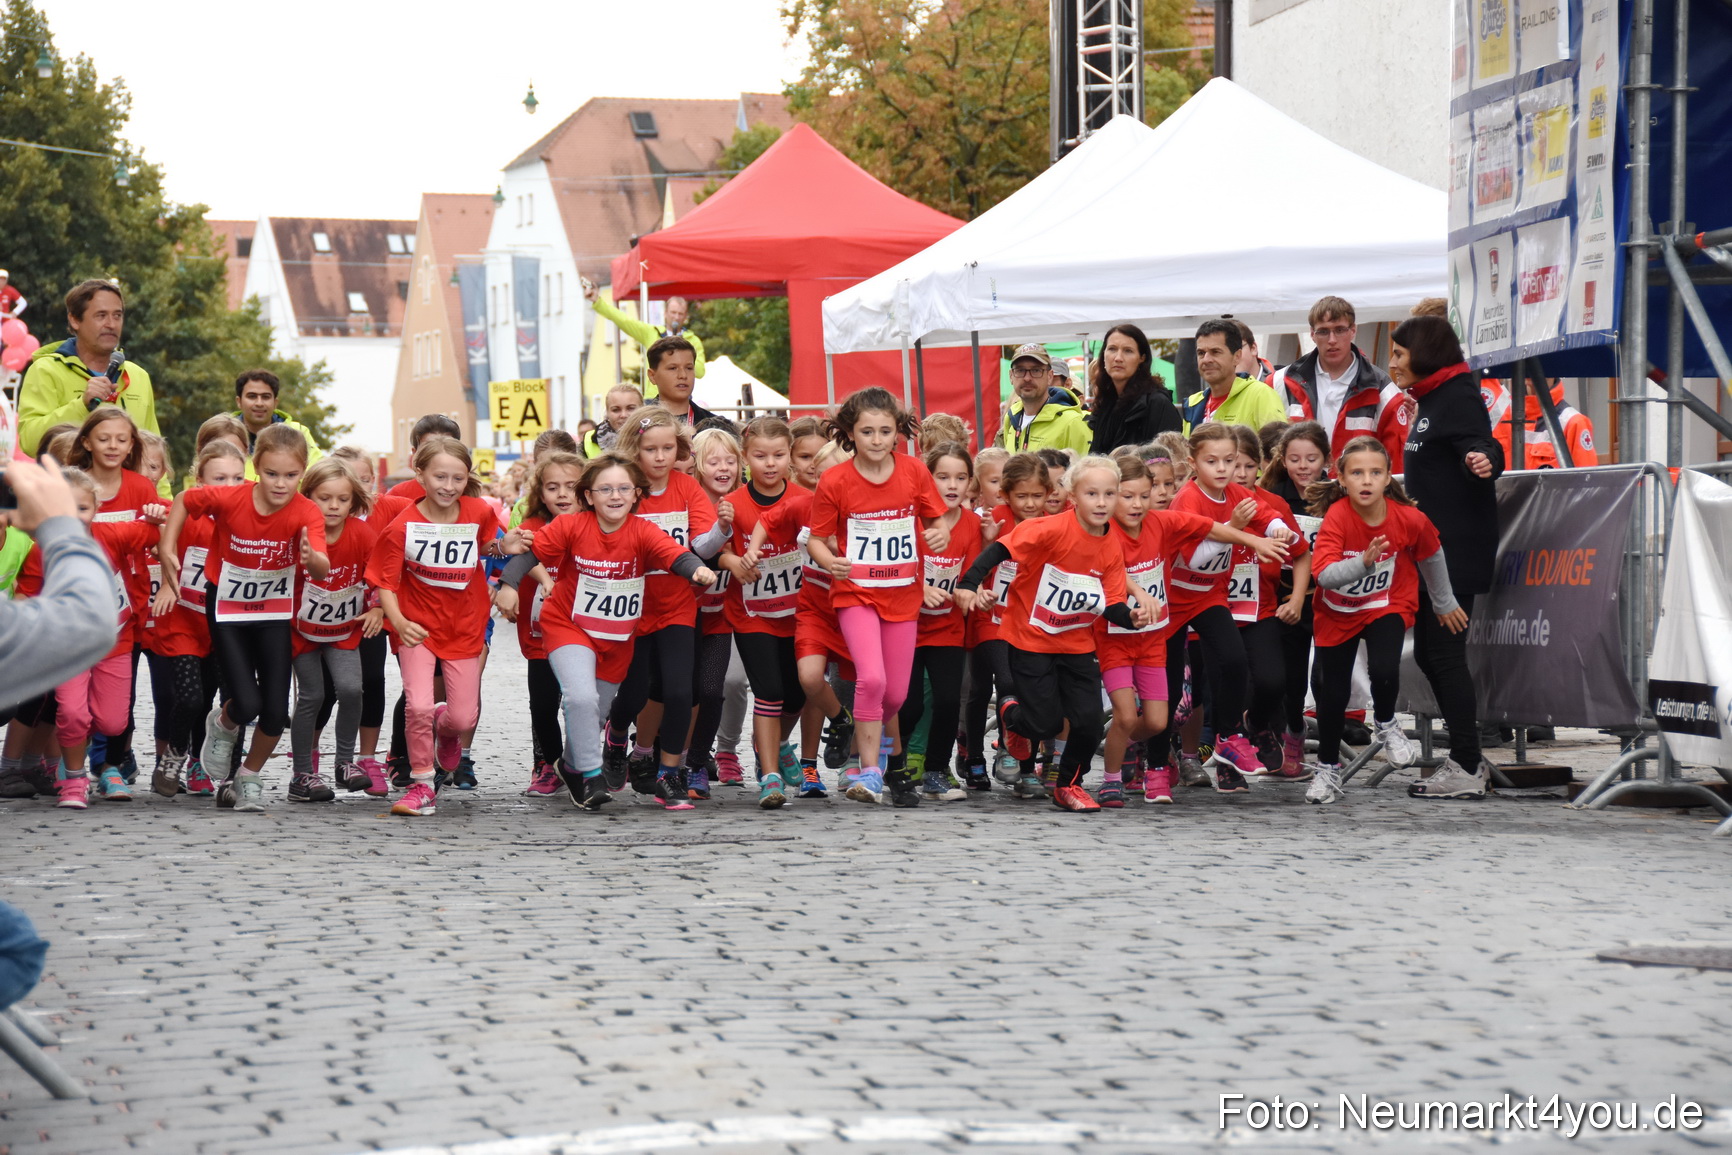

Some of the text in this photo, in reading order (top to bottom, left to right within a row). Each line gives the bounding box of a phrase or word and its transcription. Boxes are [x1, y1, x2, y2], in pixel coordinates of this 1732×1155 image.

[513, 382, 546, 393] Block
[499, 396, 510, 420] E
[519, 398, 542, 427] A
[230, 543, 268, 556] Stadtlauf
[231, 534, 278, 547] Neumarkter
[856, 535, 912, 561] 7105
[414, 540, 474, 564] 7167
[575, 555, 620, 568] Neumarkter
[415, 566, 466, 580] Annemarie
[575, 563, 610, 577] Stadtlauf
[869, 568, 899, 577] Emilia
[1525, 548, 1597, 586] LOUNGE
[228, 577, 288, 599] 7074
[1189, 573, 1215, 584] Emma
[1229, 578, 1254, 598] 24
[1346, 570, 1389, 595] 209
[584, 591, 640, 617] 7406
[1045, 582, 1100, 612] 7087
[307, 596, 357, 622] 7241
[312, 626, 350, 634] Johanna
[1048, 615, 1080, 625] Hannah
